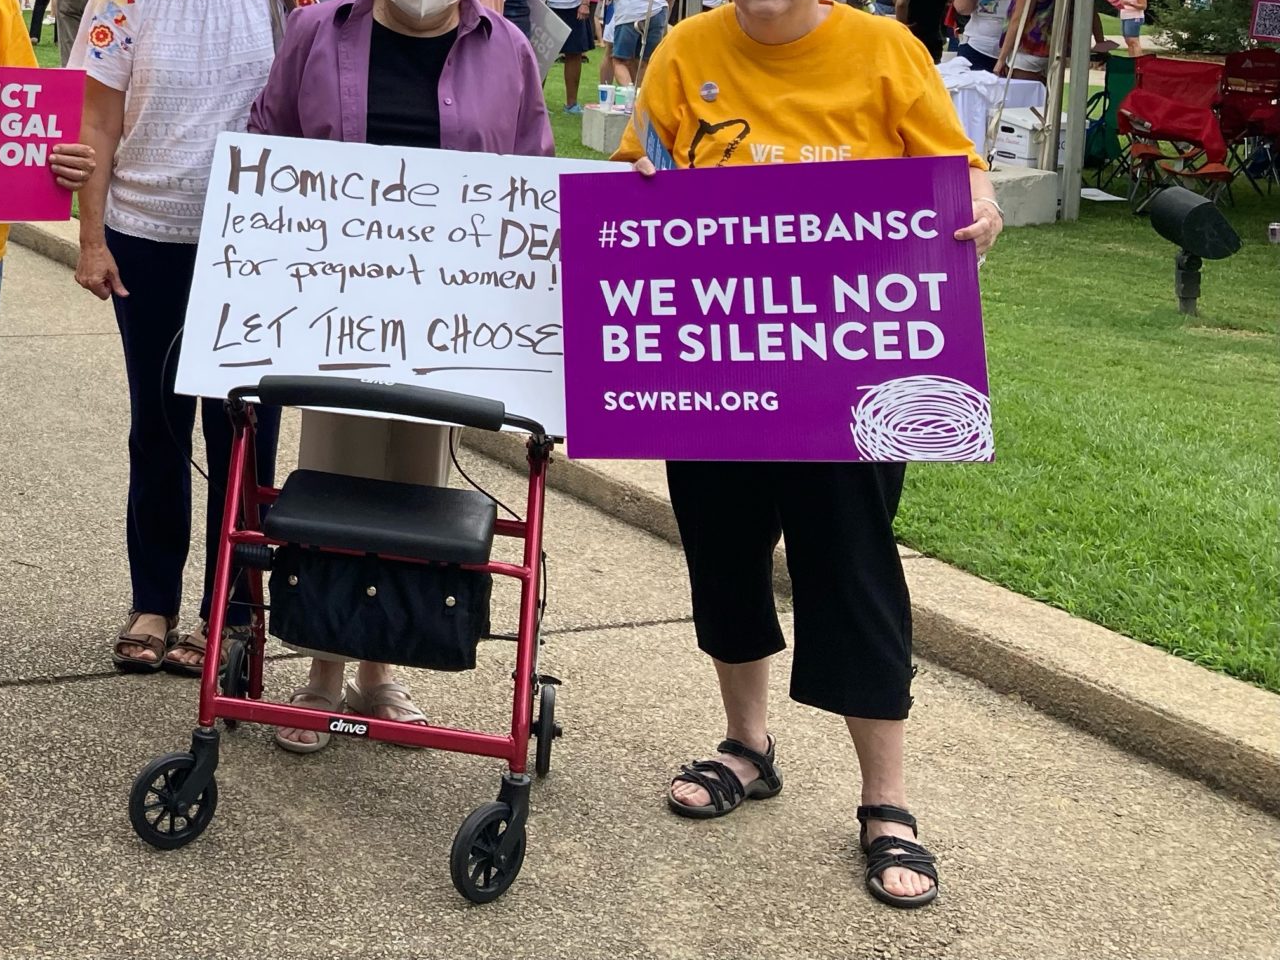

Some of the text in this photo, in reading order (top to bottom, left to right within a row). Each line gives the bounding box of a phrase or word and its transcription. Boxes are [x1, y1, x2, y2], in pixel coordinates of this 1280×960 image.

[750, 143, 785, 163] WE
[461, 175, 492, 205] is
[498, 176, 560, 214] the
[448, 213, 492, 248] of
[598, 209, 939, 249] #STOPTHEBANSC
[212, 244, 278, 279] for
[600, 272, 948, 317] WE WILL NOT
[212, 302, 564, 361] LET THEM CHOOSE
[602, 320, 945, 362] BE SILENCED
[603, 390, 779, 412] SCWREN.ORG
[330, 719, 367, 735] drive
